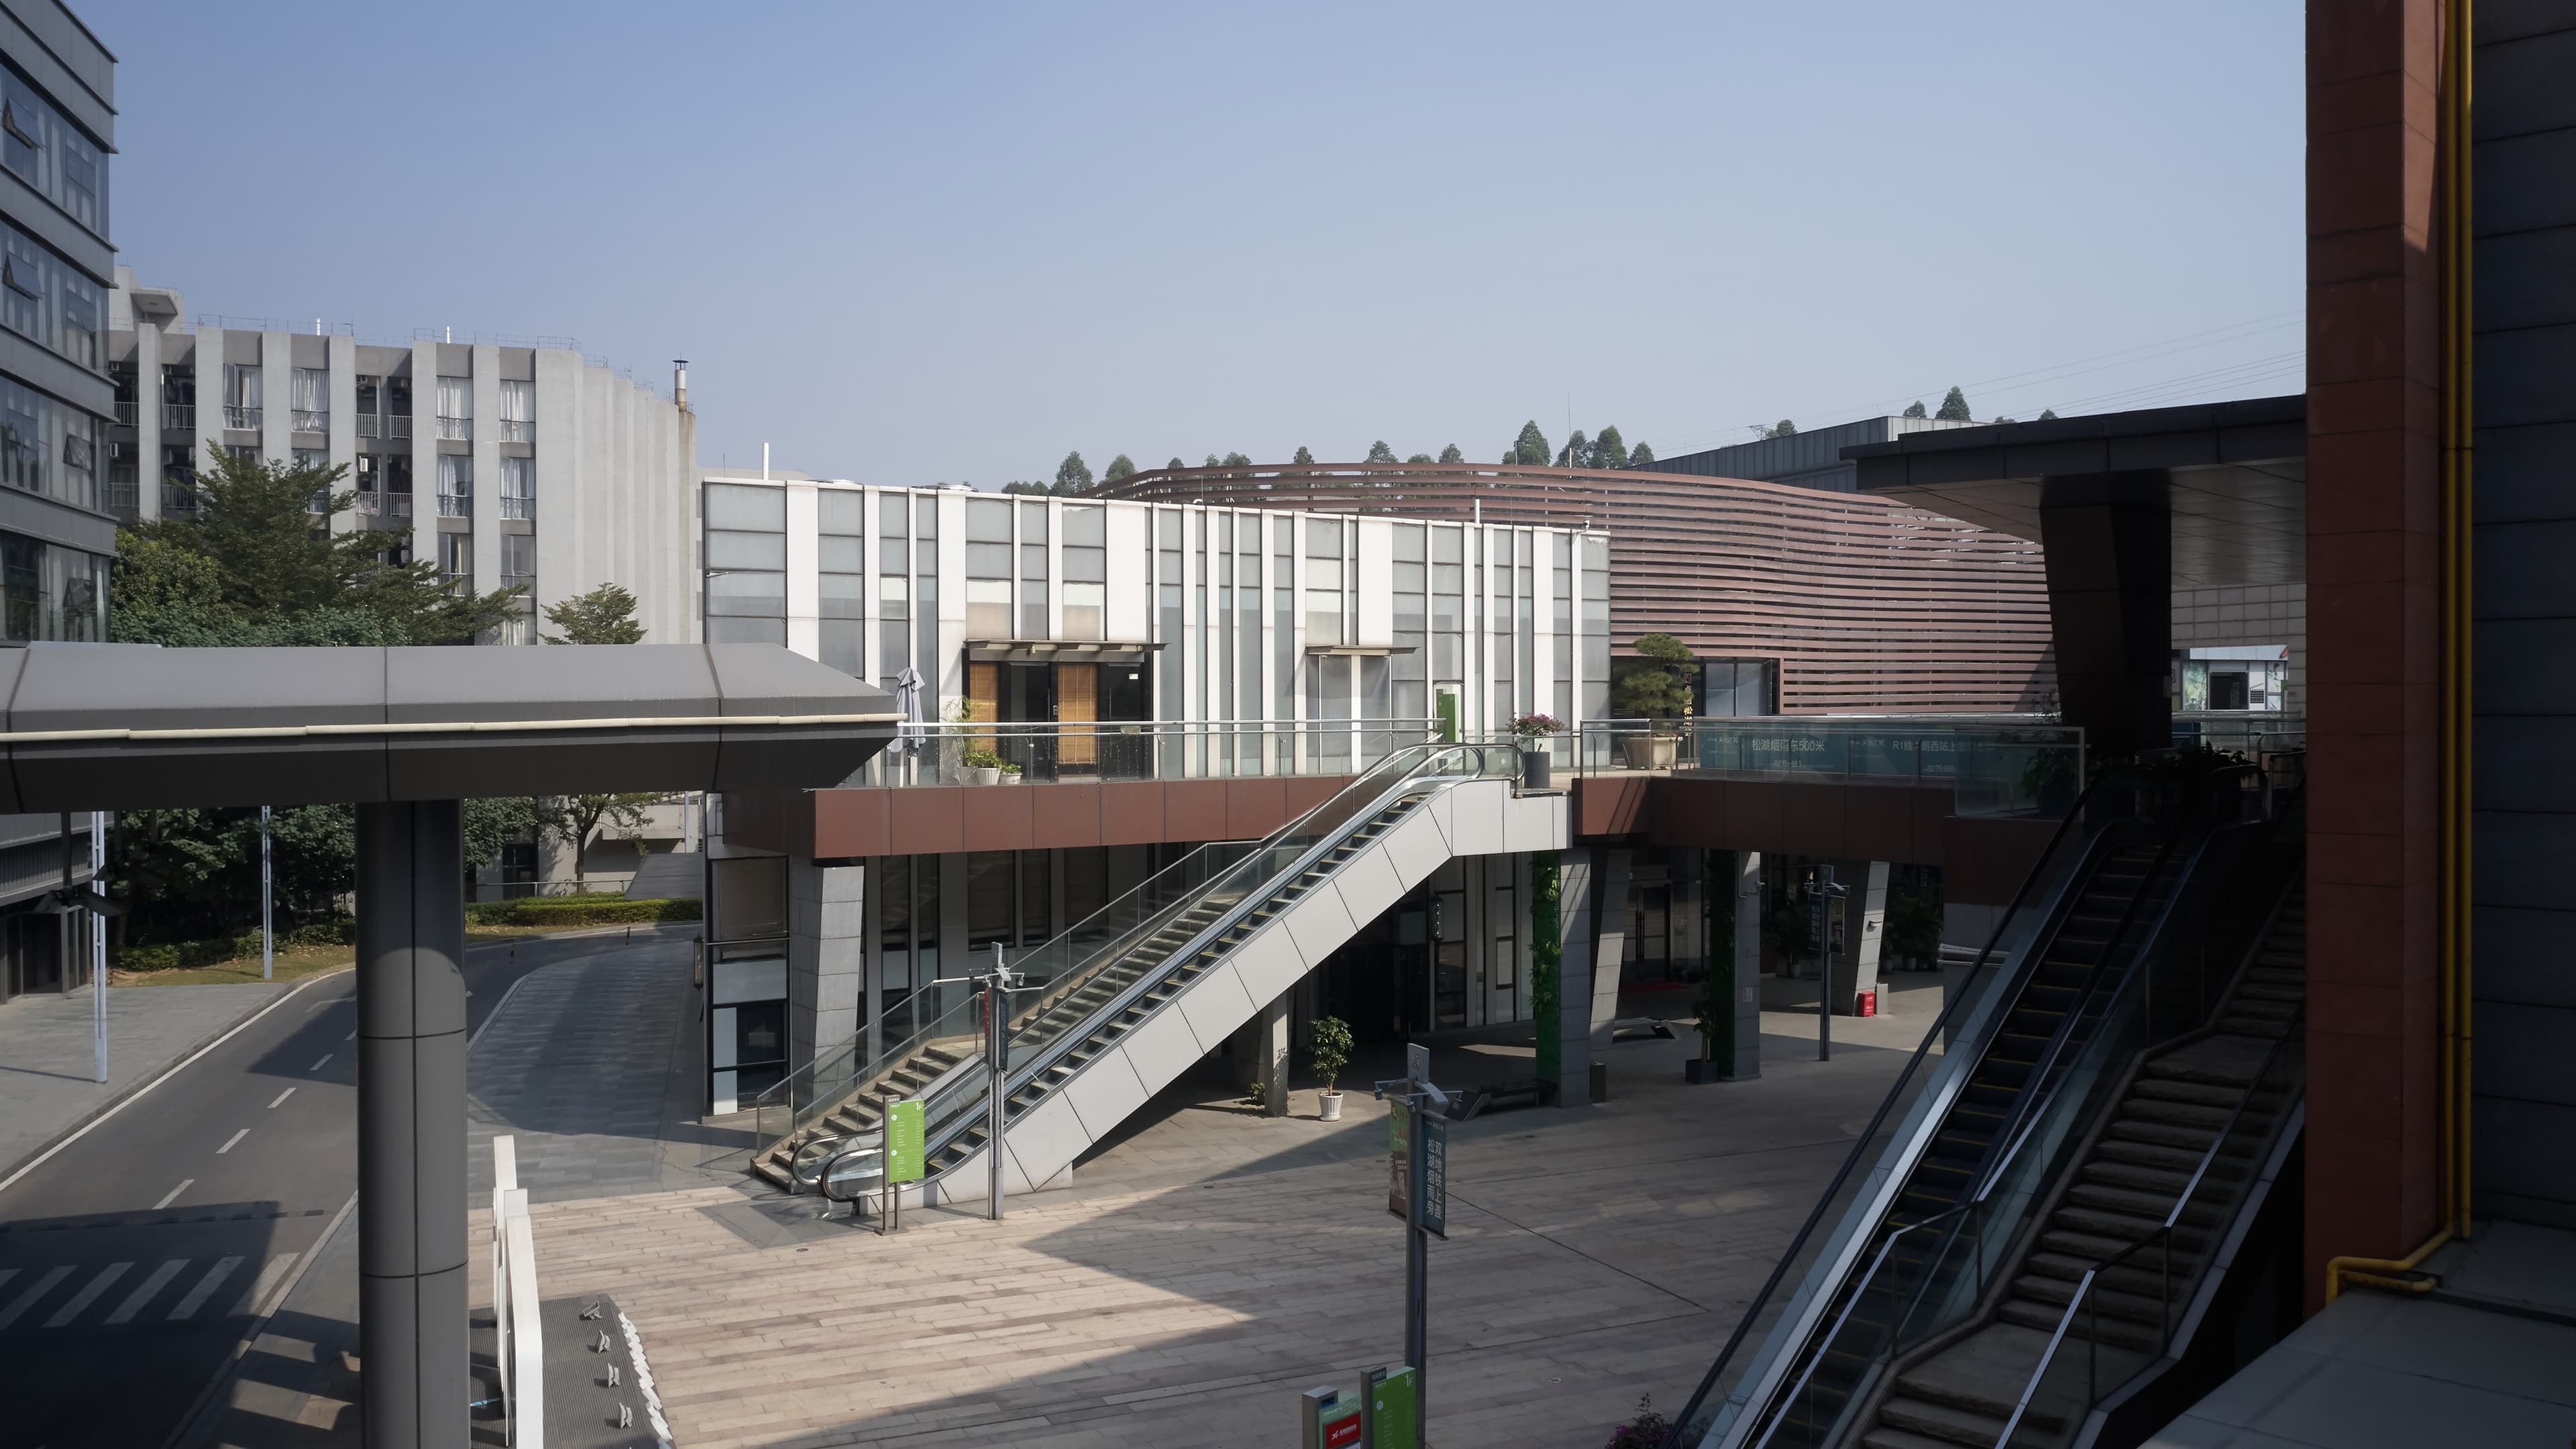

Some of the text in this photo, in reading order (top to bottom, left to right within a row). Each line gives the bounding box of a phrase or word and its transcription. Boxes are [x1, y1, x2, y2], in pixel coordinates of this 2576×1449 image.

[1752, 739, 1825, 752] 松湖烟雨东500米
[915, 1102, 923, 1112] 1F
[1405, 1374, 1413, 1387] 1F
